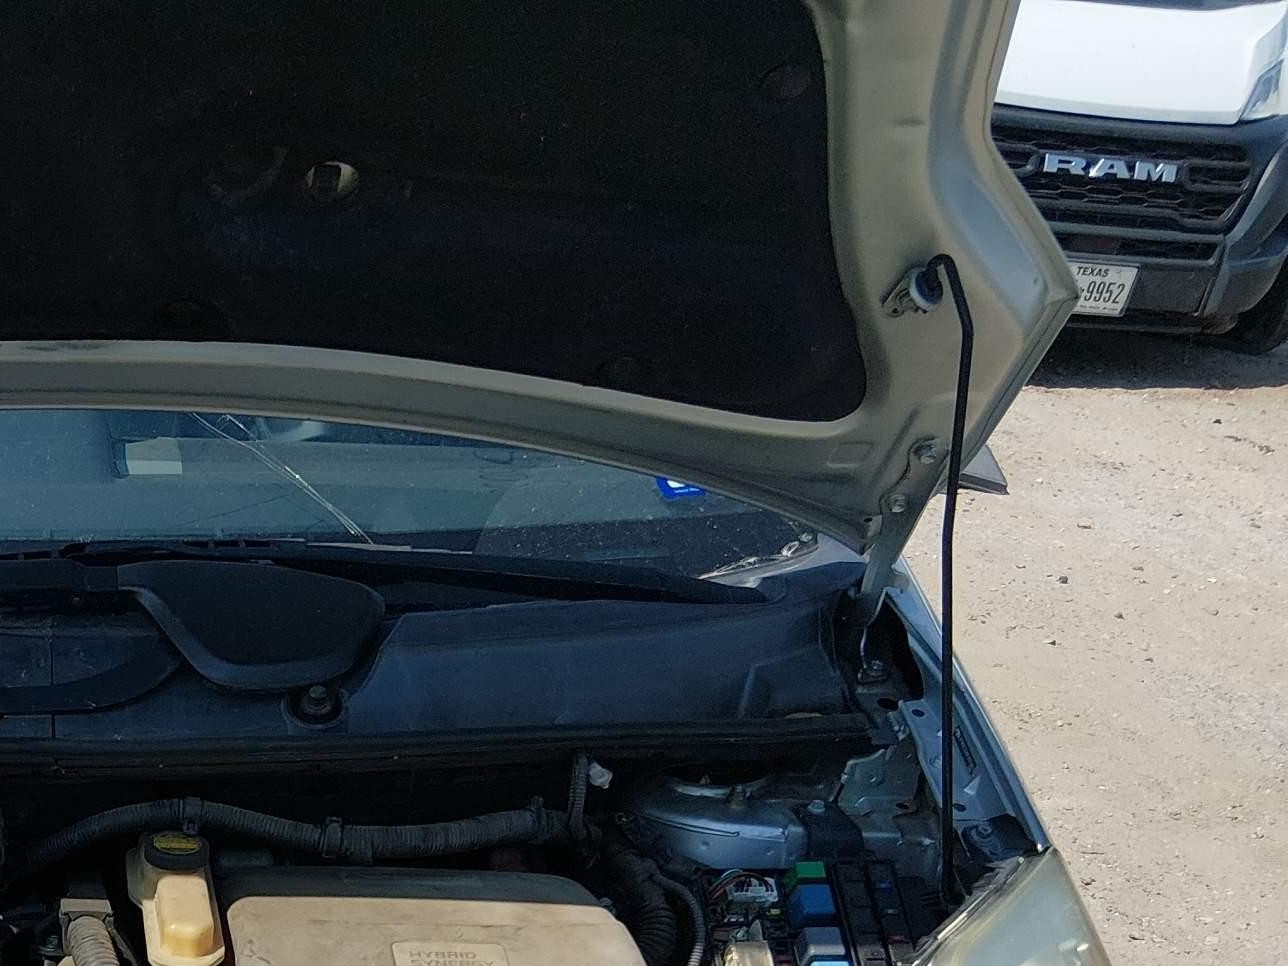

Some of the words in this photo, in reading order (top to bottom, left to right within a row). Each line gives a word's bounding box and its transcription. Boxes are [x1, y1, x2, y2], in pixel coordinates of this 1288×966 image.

[1043, 153, 1178, 183] RAM
[1077, 266, 1110, 277] TEXAS
[409, 951, 477, 959] HYBRID
